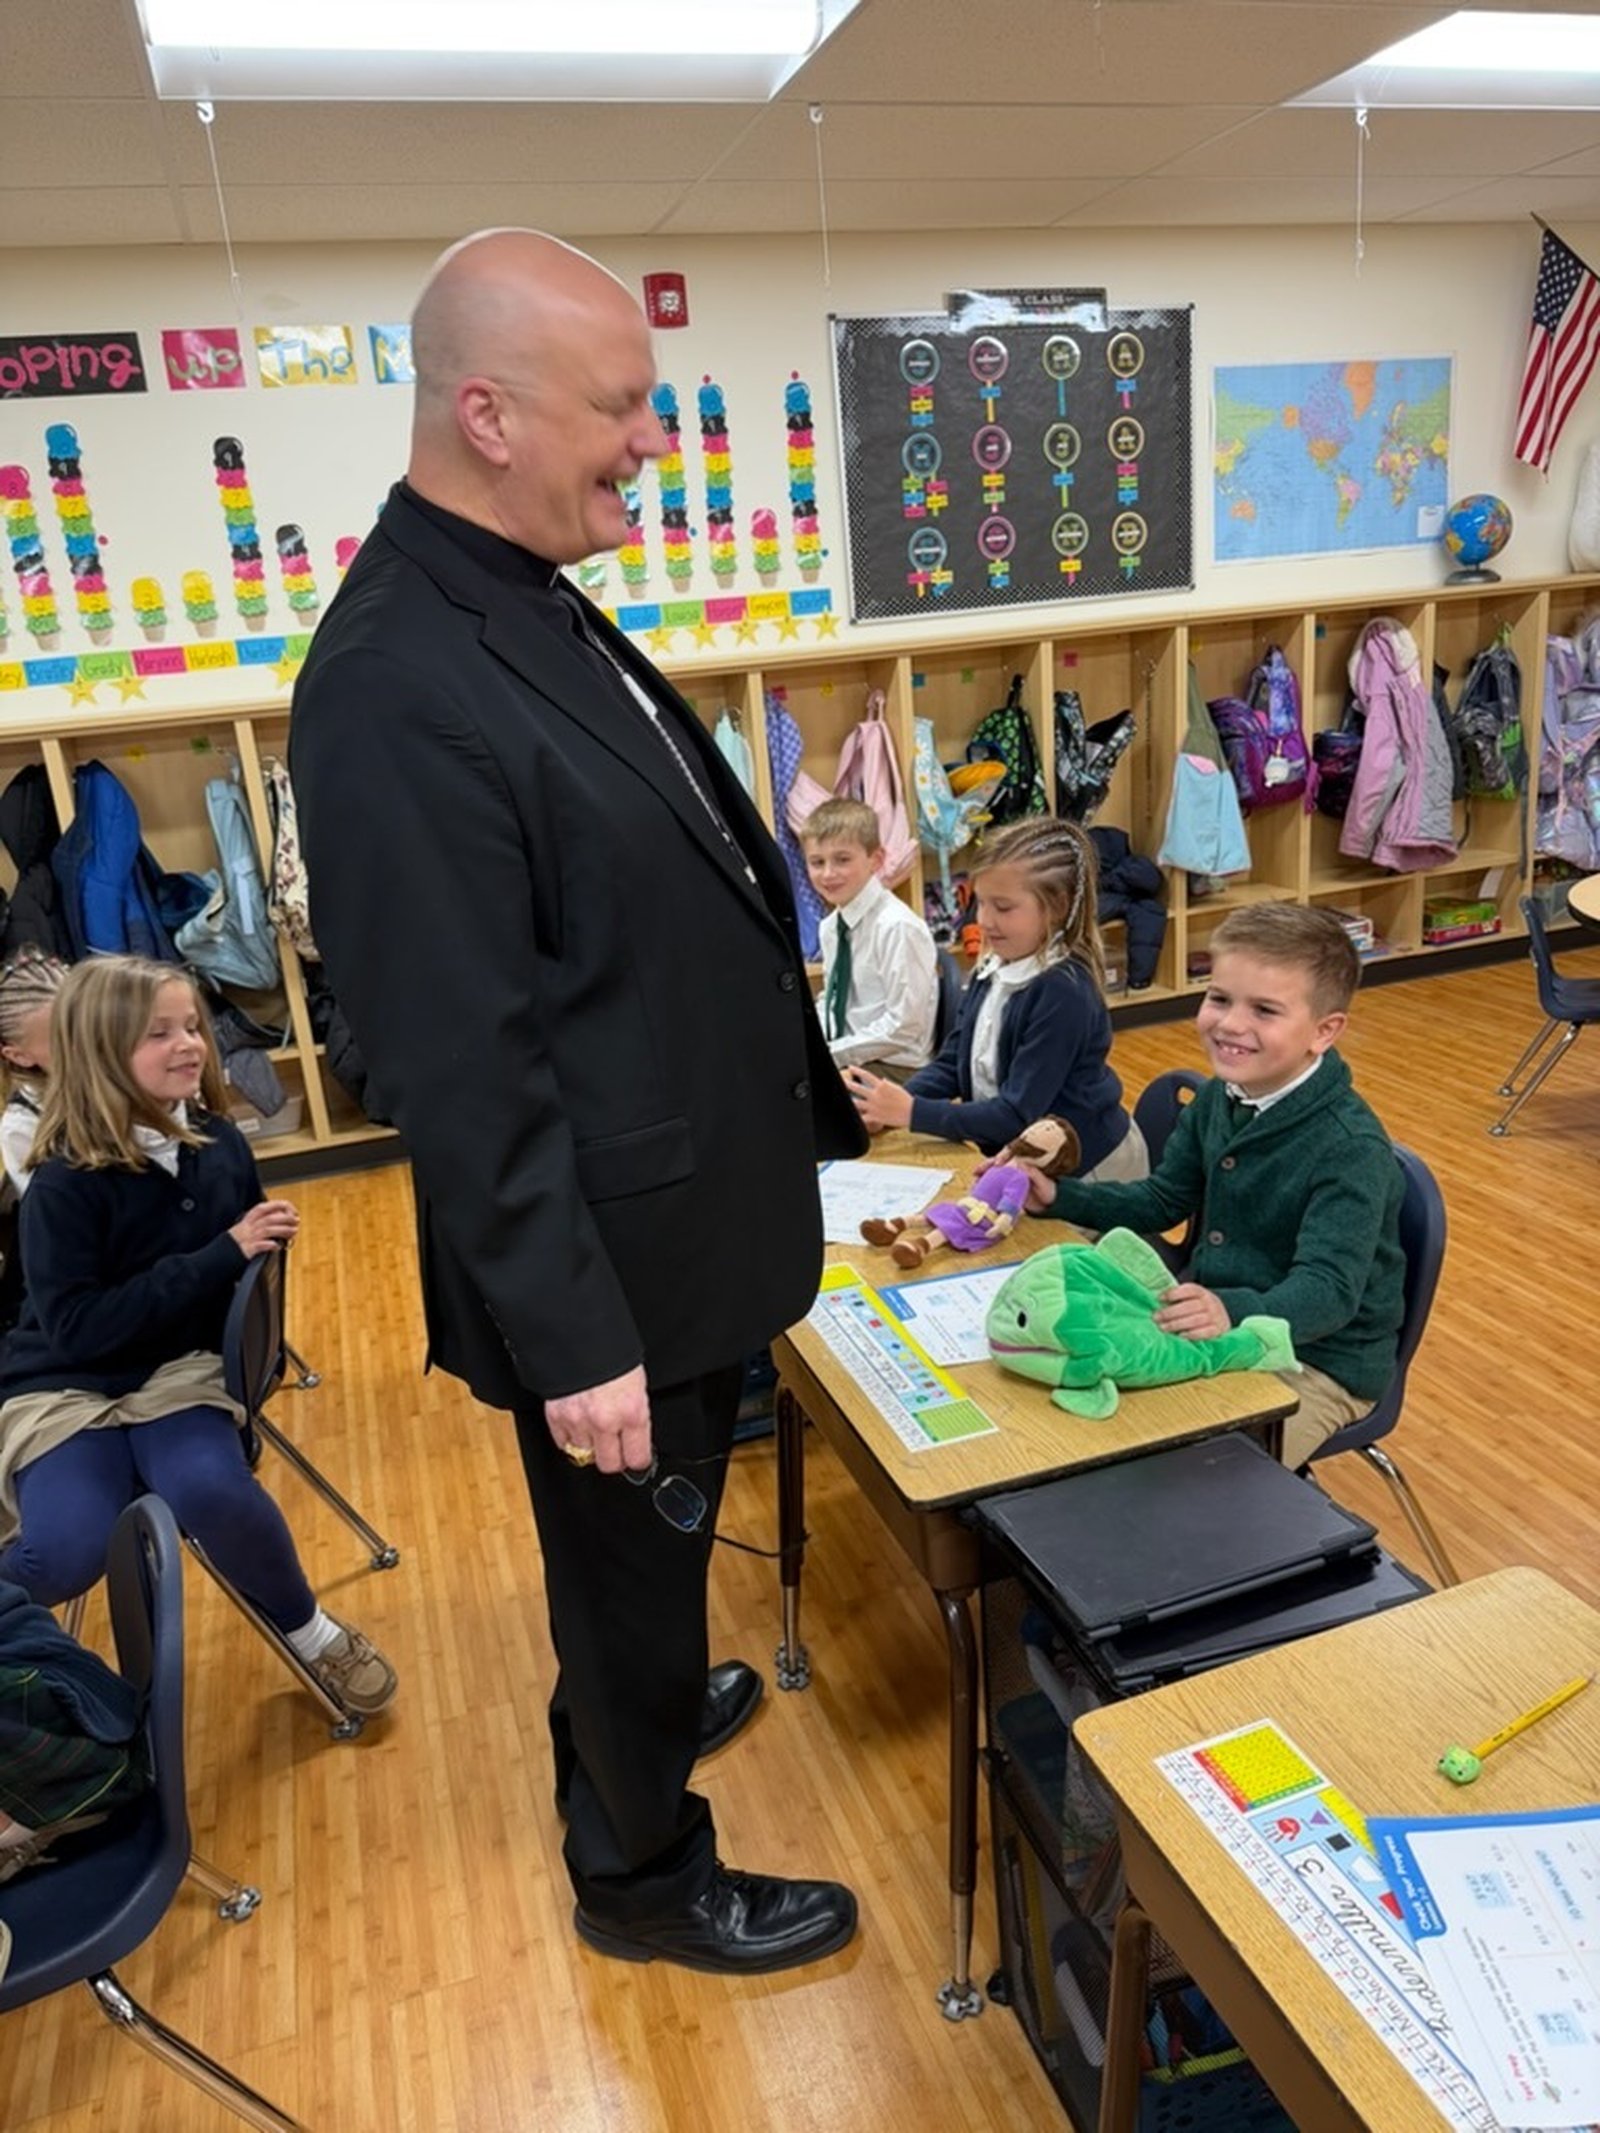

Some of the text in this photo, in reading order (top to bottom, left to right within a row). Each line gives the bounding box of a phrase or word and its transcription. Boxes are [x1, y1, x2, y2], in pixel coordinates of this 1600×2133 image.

[258, 338, 354, 380] The
[1293, 1858, 1325, 1878] 3
[1383, 1835, 1407, 1875] Progress
[1412, 1901, 1432, 1931] Check
